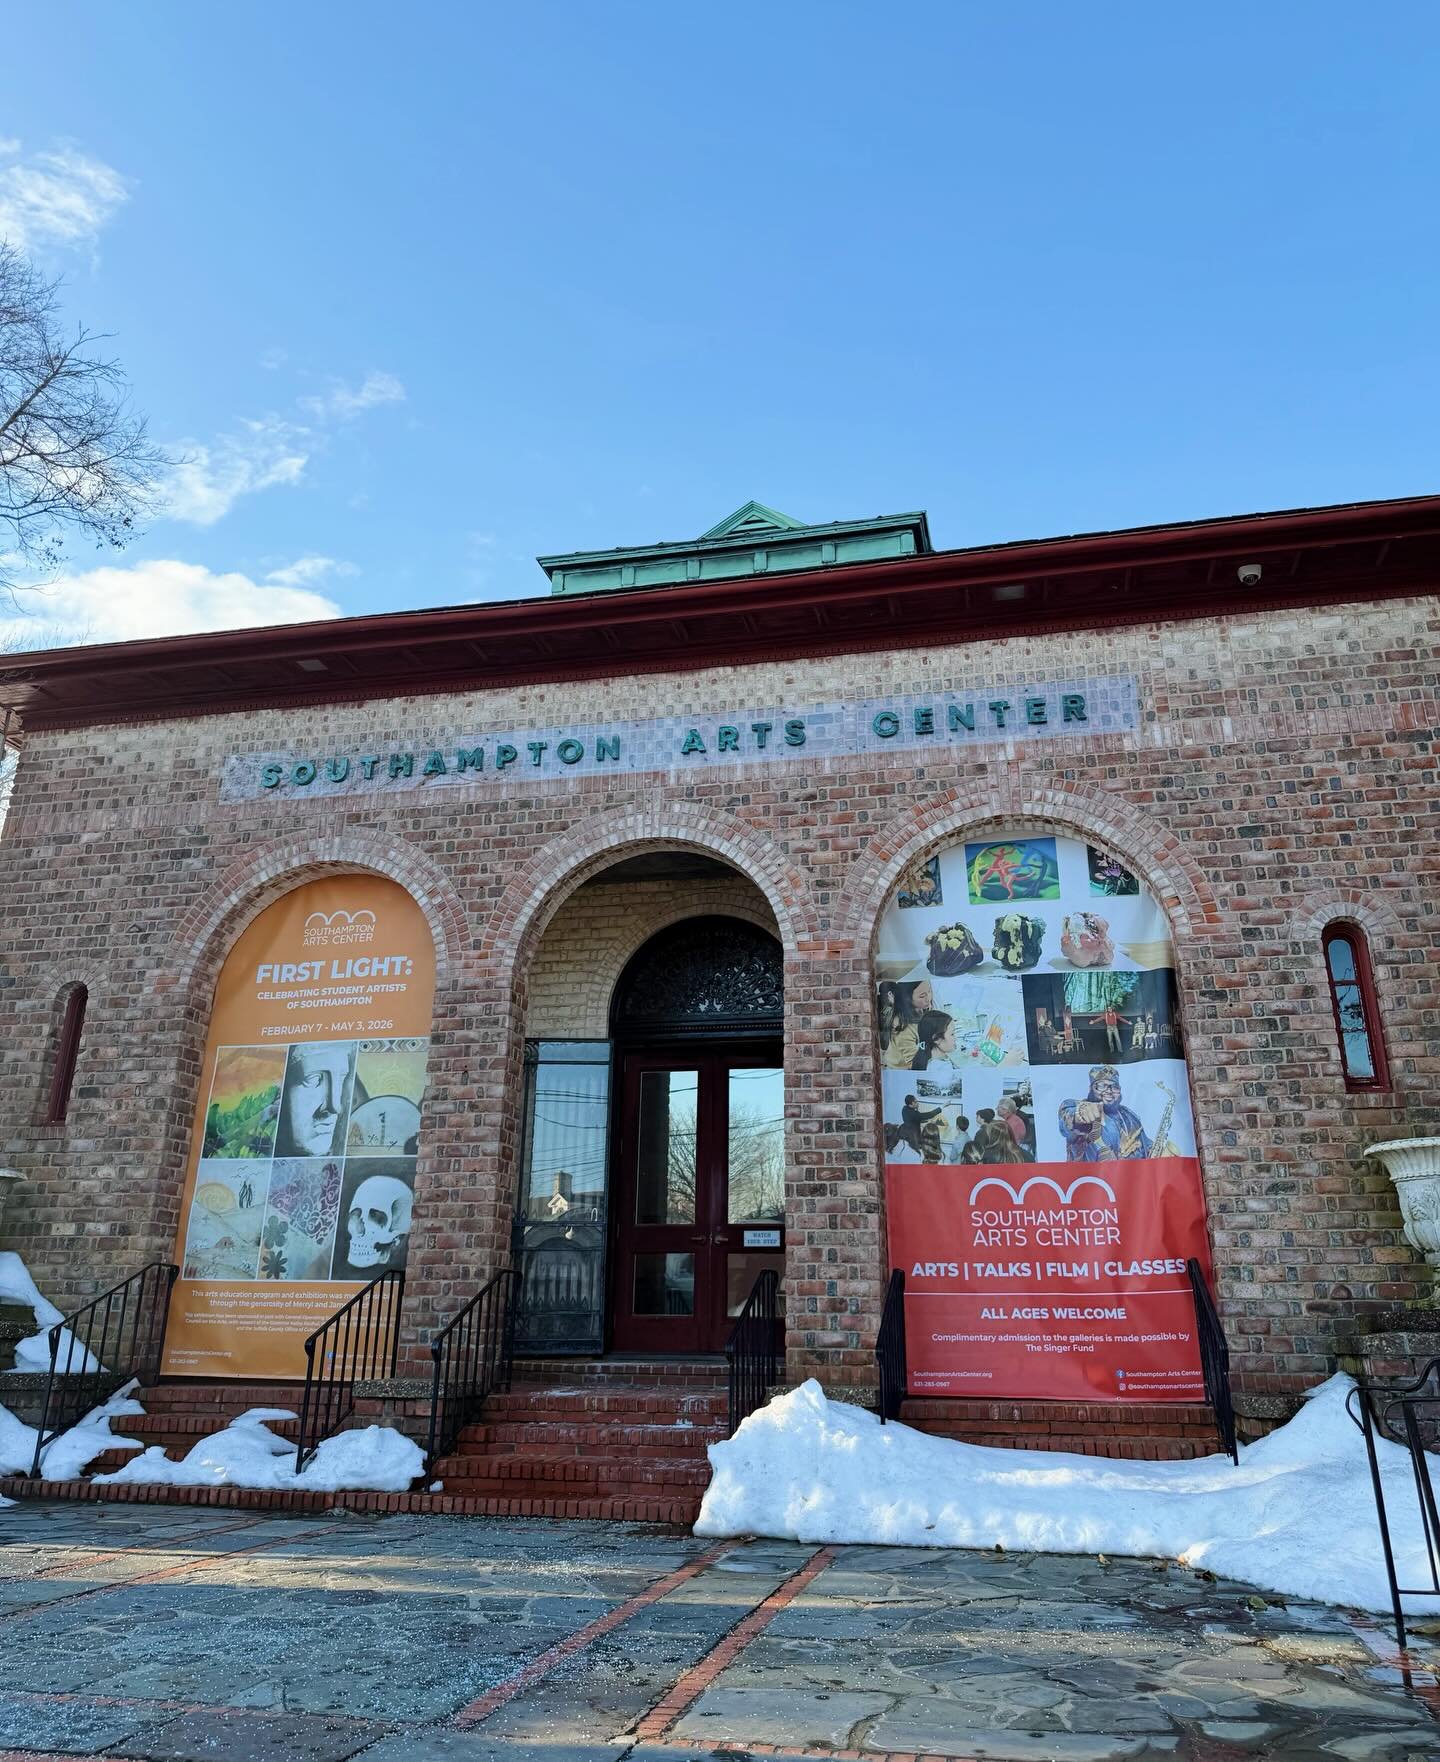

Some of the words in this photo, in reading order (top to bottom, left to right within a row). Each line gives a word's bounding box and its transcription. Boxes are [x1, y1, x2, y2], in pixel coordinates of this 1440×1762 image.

[262, 734, 621, 789] SOUTHAMPTON
[681, 719, 807, 755] ARTS
[872, 693, 1088, 738] CENTER
[303, 924, 376, 938] SOUTHAMPTON
[303, 935, 328, 946] ARTS
[332, 932, 374, 945] CENTER
[255, 960, 327, 984] FIRST
[330, 955, 414, 979] LIGHT:
[257, 988, 320, 1000] CELEBRATING
[320, 984, 365, 996] STUDENT
[366, 983, 407, 993] ARTISTS
[287, 1001, 300, 1010] OF
[300, 996, 373, 1009] SOUTHAMPTON
[261, 1023, 314, 1036] FEBRUARY
[315, 1023, 323, 1032] 7
[331, 1021, 355, 1032] MAY
[355, 1020, 365, 1032] 3,
[367, 1019, 393, 1030] 2026
[971, 1208, 1119, 1227] SOUTHAMPTON
[973, 1228, 1028, 1247] ARTS
[1035, 1227, 1121, 1246] CENTER
[911, 1262, 959, 1277] ARTS
[973, 1262, 1031, 1277] TALKS
[1046, 1261, 1089, 1277] FILM
[1104, 1258, 1186, 1277] CLASSES
[219, 1290, 252, 1298] education
[253, 1291, 281, 1300] program
[281, 1291, 294, 1299] and
[209, 1299, 238, 1308] through
[980, 1307, 1008, 1320] ALL
[1011, 1307, 1049, 1320] AGES
[1052, 1307, 1127, 1320] WELCOME
[931, 1333, 996, 1343] Complimentary
[998, 1333, 1041, 1342] admission
[1042, 1334, 1052, 1342] to
[1053, 1333, 1068, 1342] the
[1069, 1333, 1104, 1343] galleries
[1105, 1334, 1113, 1342] is
[1114, 1334, 1140, 1342] made
[1141, 1332, 1177, 1343] possible
[1178, 1332, 1190, 1342] by
[1026, 1344, 1042, 1352] The
[1043, 1344, 1070, 1353] Singer
[1072, 1344, 1095, 1352] Fund
